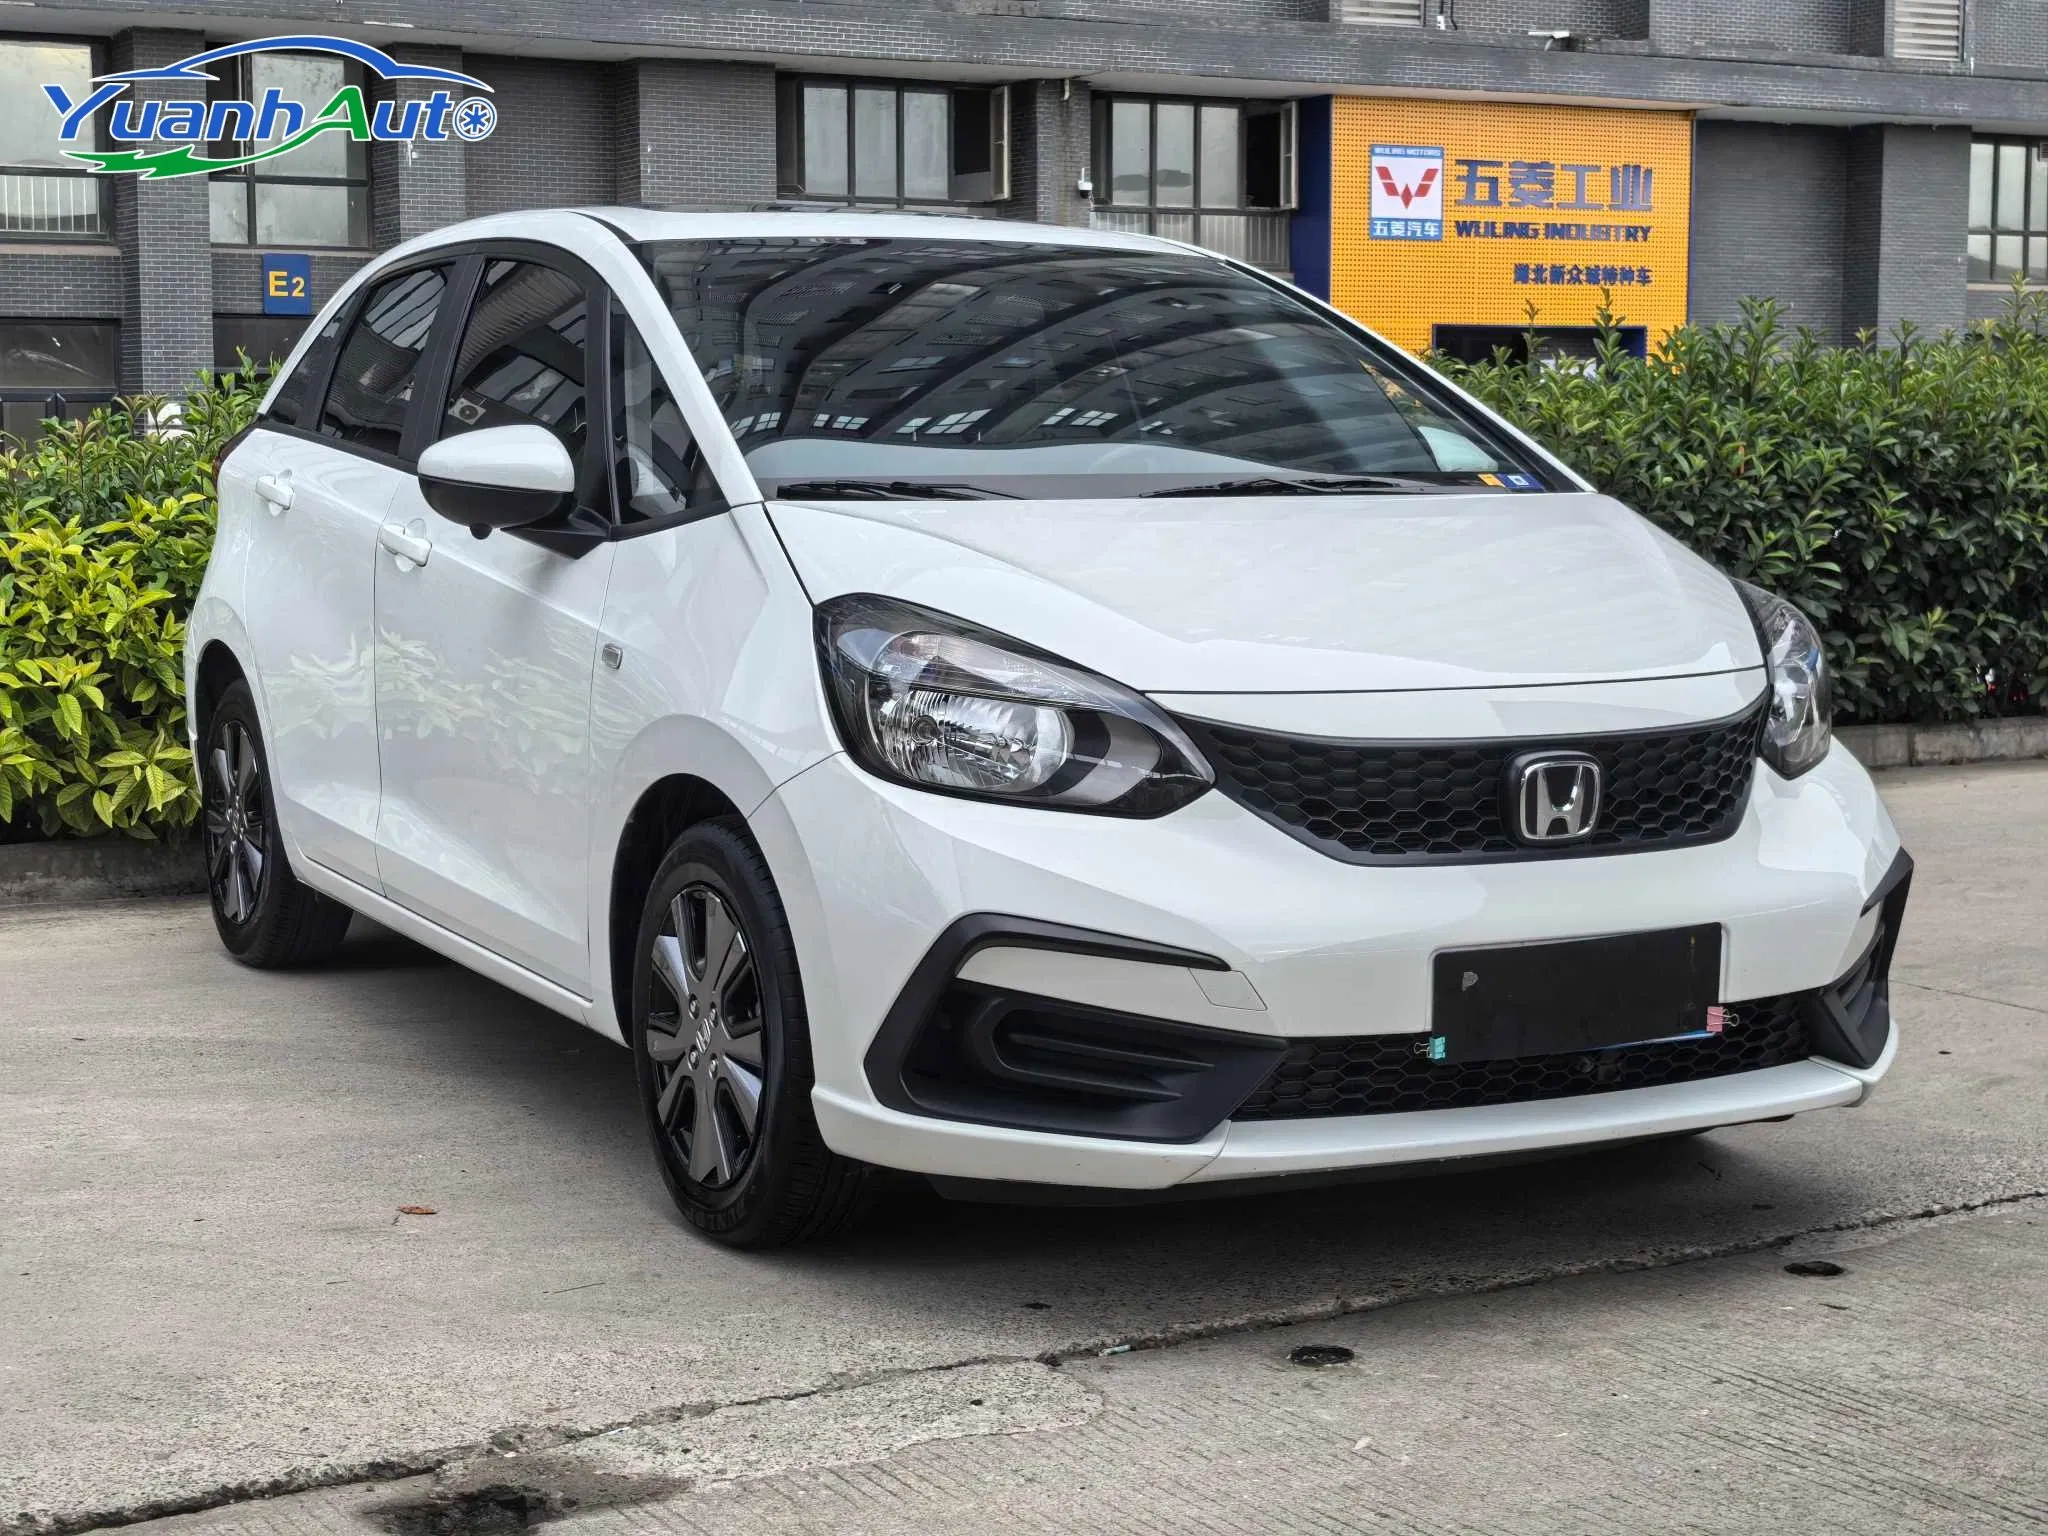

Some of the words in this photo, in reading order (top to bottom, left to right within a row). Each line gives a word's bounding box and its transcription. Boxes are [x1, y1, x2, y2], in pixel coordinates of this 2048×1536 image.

[1455, 159, 1653, 211] 五菱工业
[1373, 220, 1440, 237] 五菱汽车
[1454, 220, 1540, 240] WULING
[1544, 223, 1652, 243] INDUSTRY
[268, 271, 305, 297] E2
